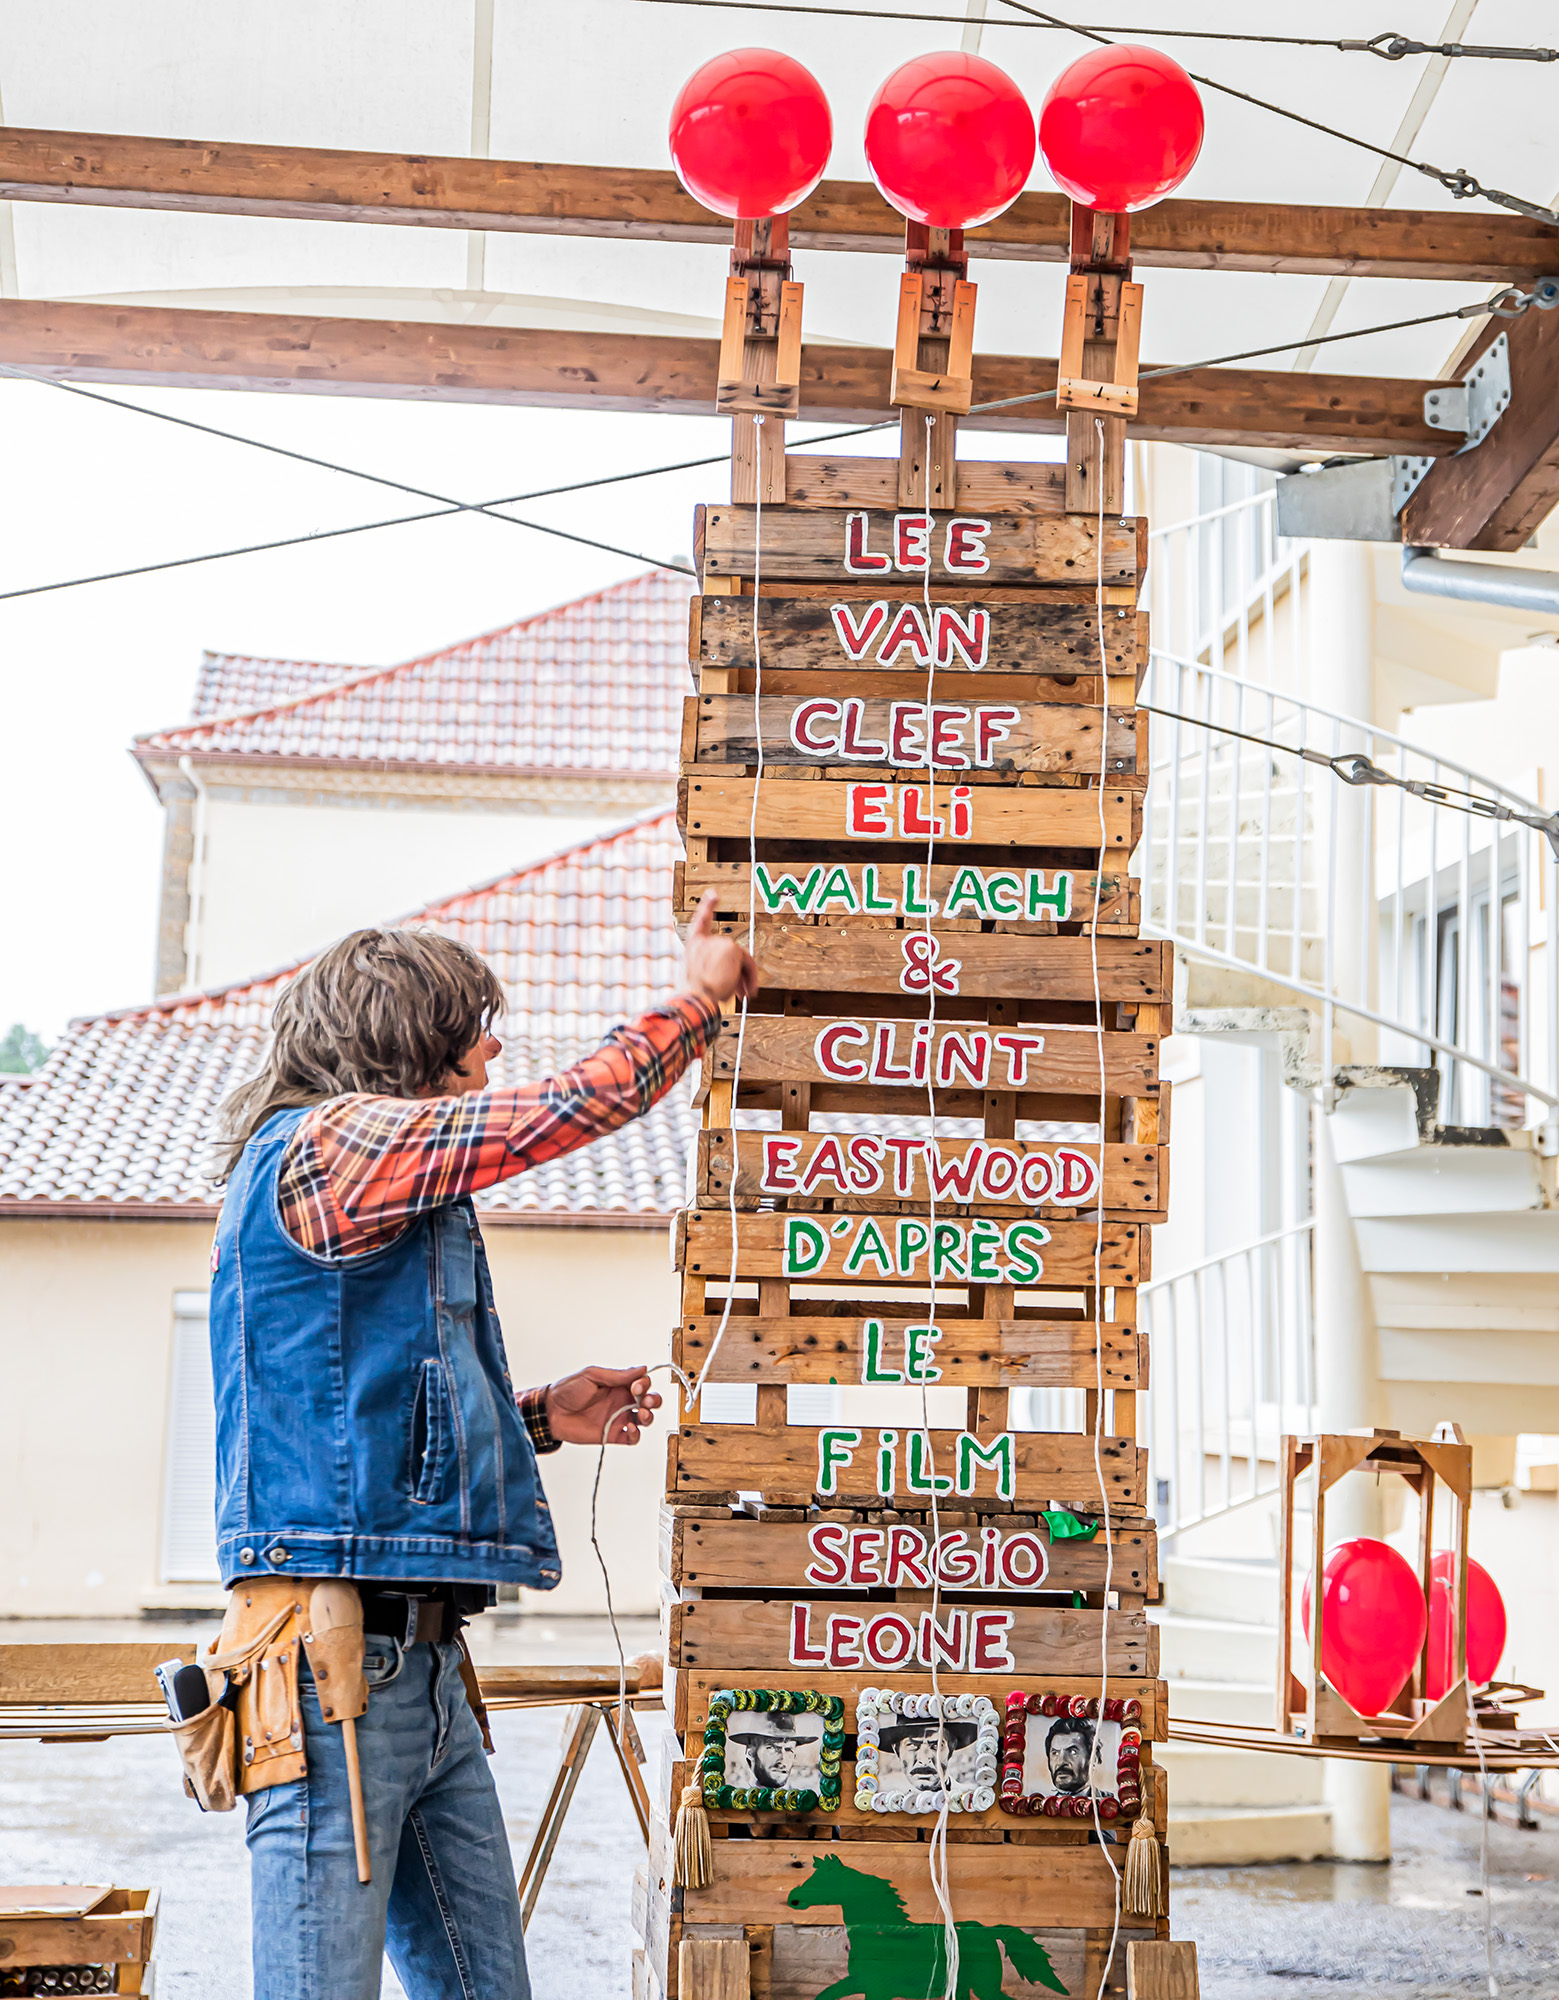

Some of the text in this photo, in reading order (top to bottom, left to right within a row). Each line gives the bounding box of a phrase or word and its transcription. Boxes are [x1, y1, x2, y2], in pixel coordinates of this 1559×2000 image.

[846, 512, 990, 573] LEE
[831, 601, 989, 670] VAN
[791, 698, 1020, 769] CLEEF
[756, 863, 1072, 921] WALLACH
[901, 933, 961, 995] &
[761, 1136, 1098, 1205] EASTWOOD
[863, 1319, 942, 1385] LE
[789, 1603, 1014, 1671] LEONE
